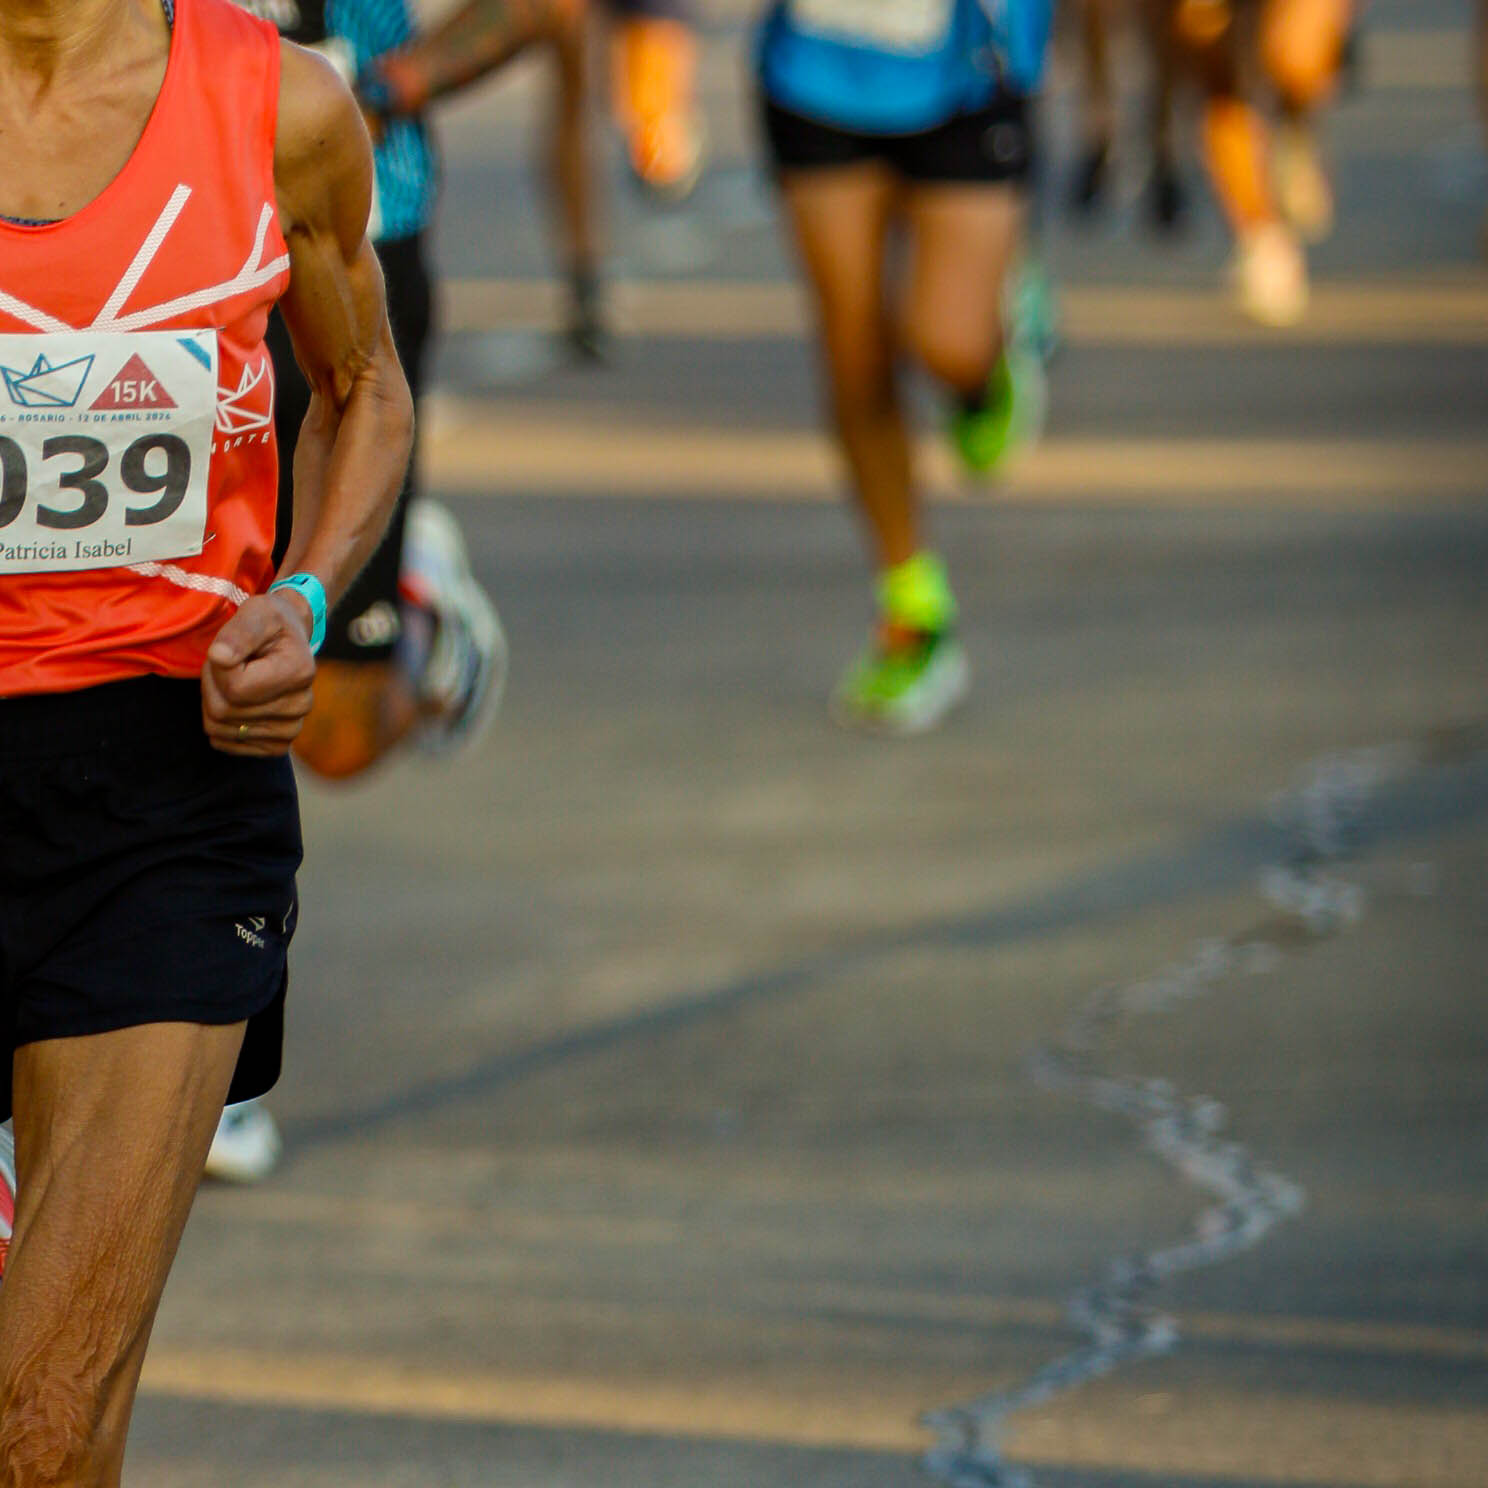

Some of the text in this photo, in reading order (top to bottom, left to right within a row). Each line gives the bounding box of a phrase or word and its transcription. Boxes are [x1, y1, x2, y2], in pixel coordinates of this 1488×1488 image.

[112, 380, 157, 403] 15K
[18, 413, 65, 423] ROSARIO
[78, 413, 89, 423] 12
[93, 413, 106, 423] DE
[111, 412, 142, 422] ABRIL
[74, 537, 132, 558] Isabel
